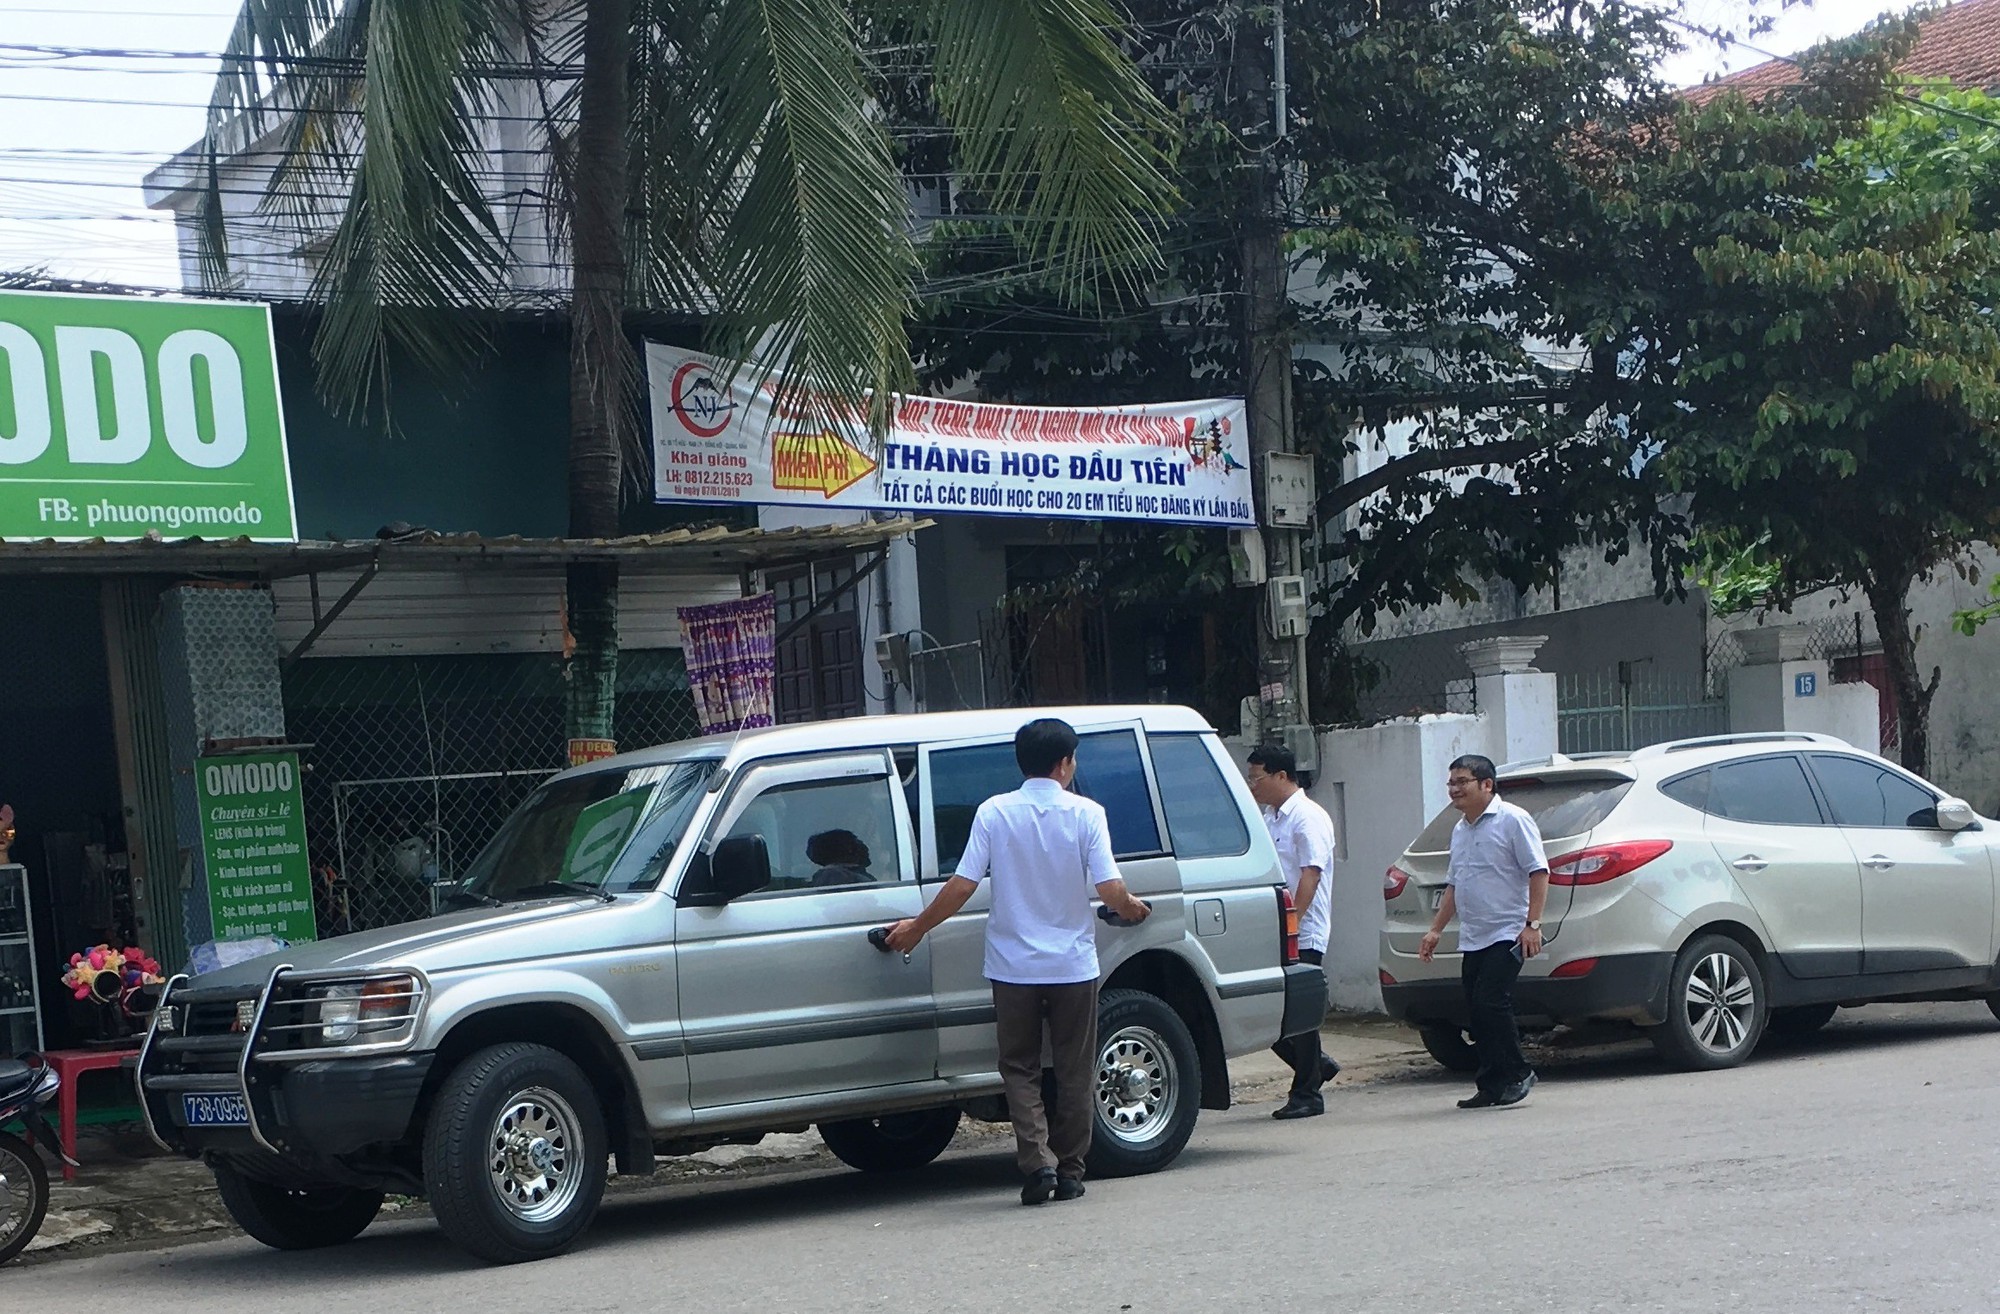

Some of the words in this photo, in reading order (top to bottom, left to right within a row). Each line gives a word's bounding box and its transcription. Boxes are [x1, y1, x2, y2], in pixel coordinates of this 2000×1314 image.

[897, 399, 930, 438] HỌC
[1010, 408, 1040, 442] CHO
[1153, 416, 1184, 456] HỌC
[671, 450, 703, 465] Khai
[707, 452, 747, 468] giảng
[885, 441, 990, 475] THÁNG
[1000, 451, 1060, 483] HỌC
[1069, 449, 1122, 482] ĐẦU
[1131, 457, 1185, 486] TIÊN
[666, 469, 682, 483] LH:
[685, 470, 753, 486] 0812.215.623
[883, 477, 909, 502] TẤT
[914, 478, 933, 503] CẢ
[938, 482, 966, 505] CÁC
[970, 481, 1002, 507] BUỔI
[1007, 489, 1033, 511] HỌC
[1037, 490, 1063, 509] CHO
[1066, 492, 1082, 510] 20
[1085, 493, 1104, 511] EM
[1107, 488, 1132, 512] TIỂU
[1136, 494, 1158, 517] HỌC
[1161, 494, 1190, 515] ĐĂNG
[1193, 496, 1206, 516] KÝ
[38, 498, 79, 522] FB:
[87, 499, 262, 528] phuongomodo
[1800, 676, 1812, 693] 15
[205, 761, 293, 796] OMODO
[211, 804, 255, 822] Chuyên
[214, 827, 234, 840] LENS
